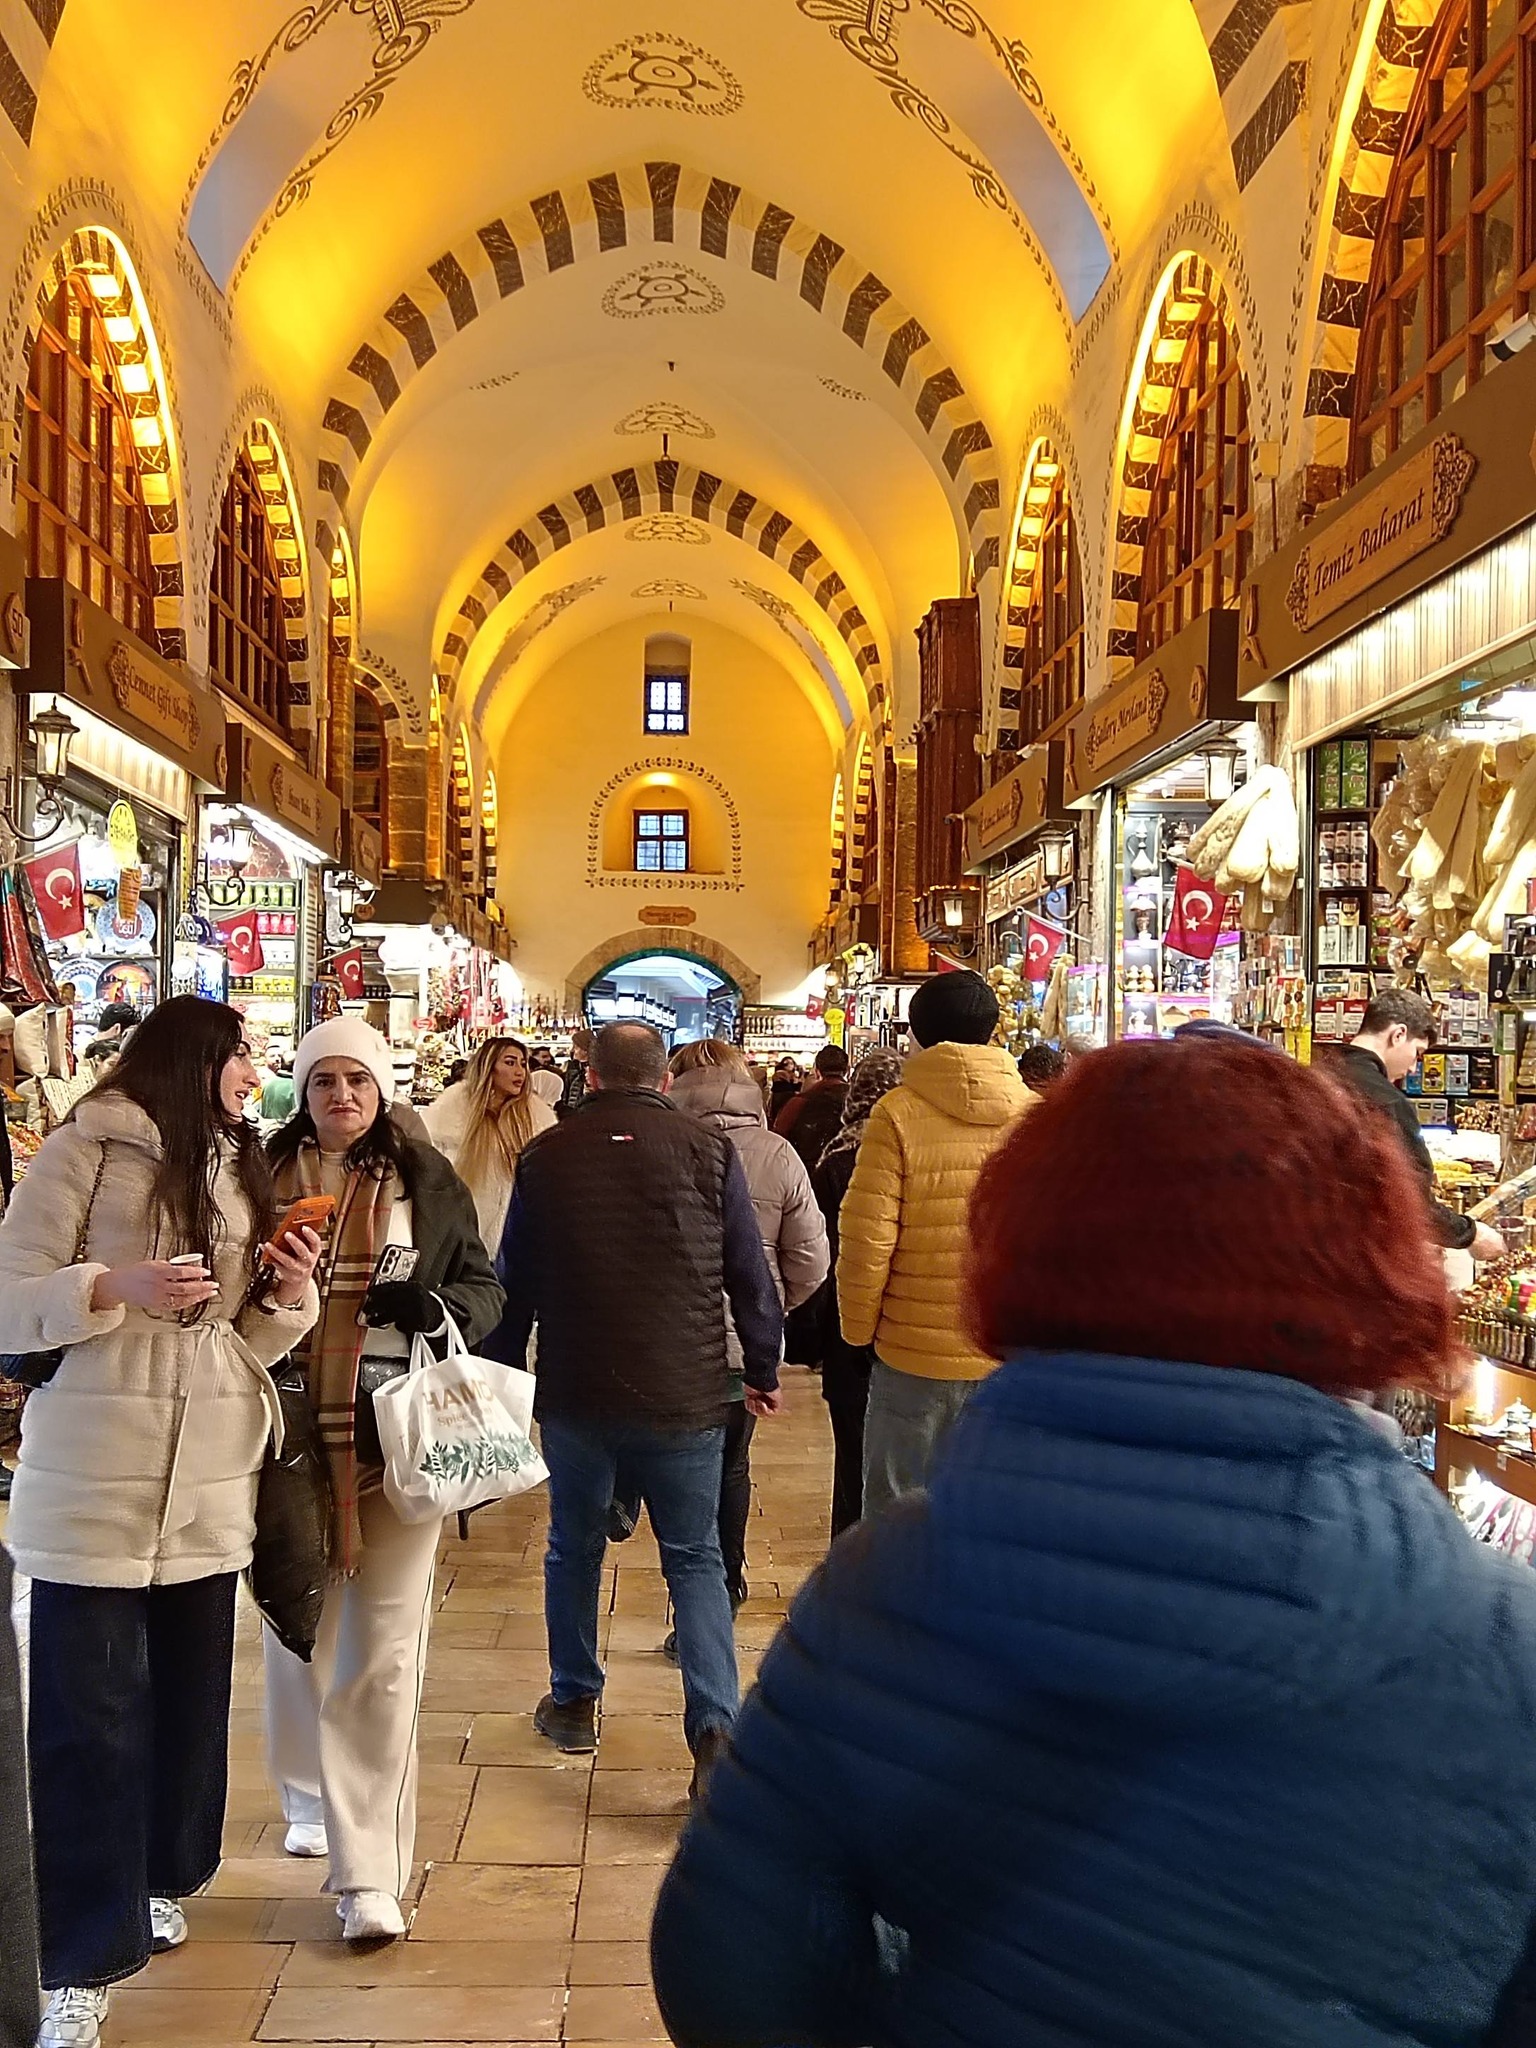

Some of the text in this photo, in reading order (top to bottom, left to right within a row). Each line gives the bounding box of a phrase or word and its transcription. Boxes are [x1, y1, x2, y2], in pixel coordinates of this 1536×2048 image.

[1313, 487, 1425, 596] Temiz Baharat
[12, 607, 24, 638] 50
[156, 685, 172, 720] Gift
[172, 695, 190, 734] Shop
